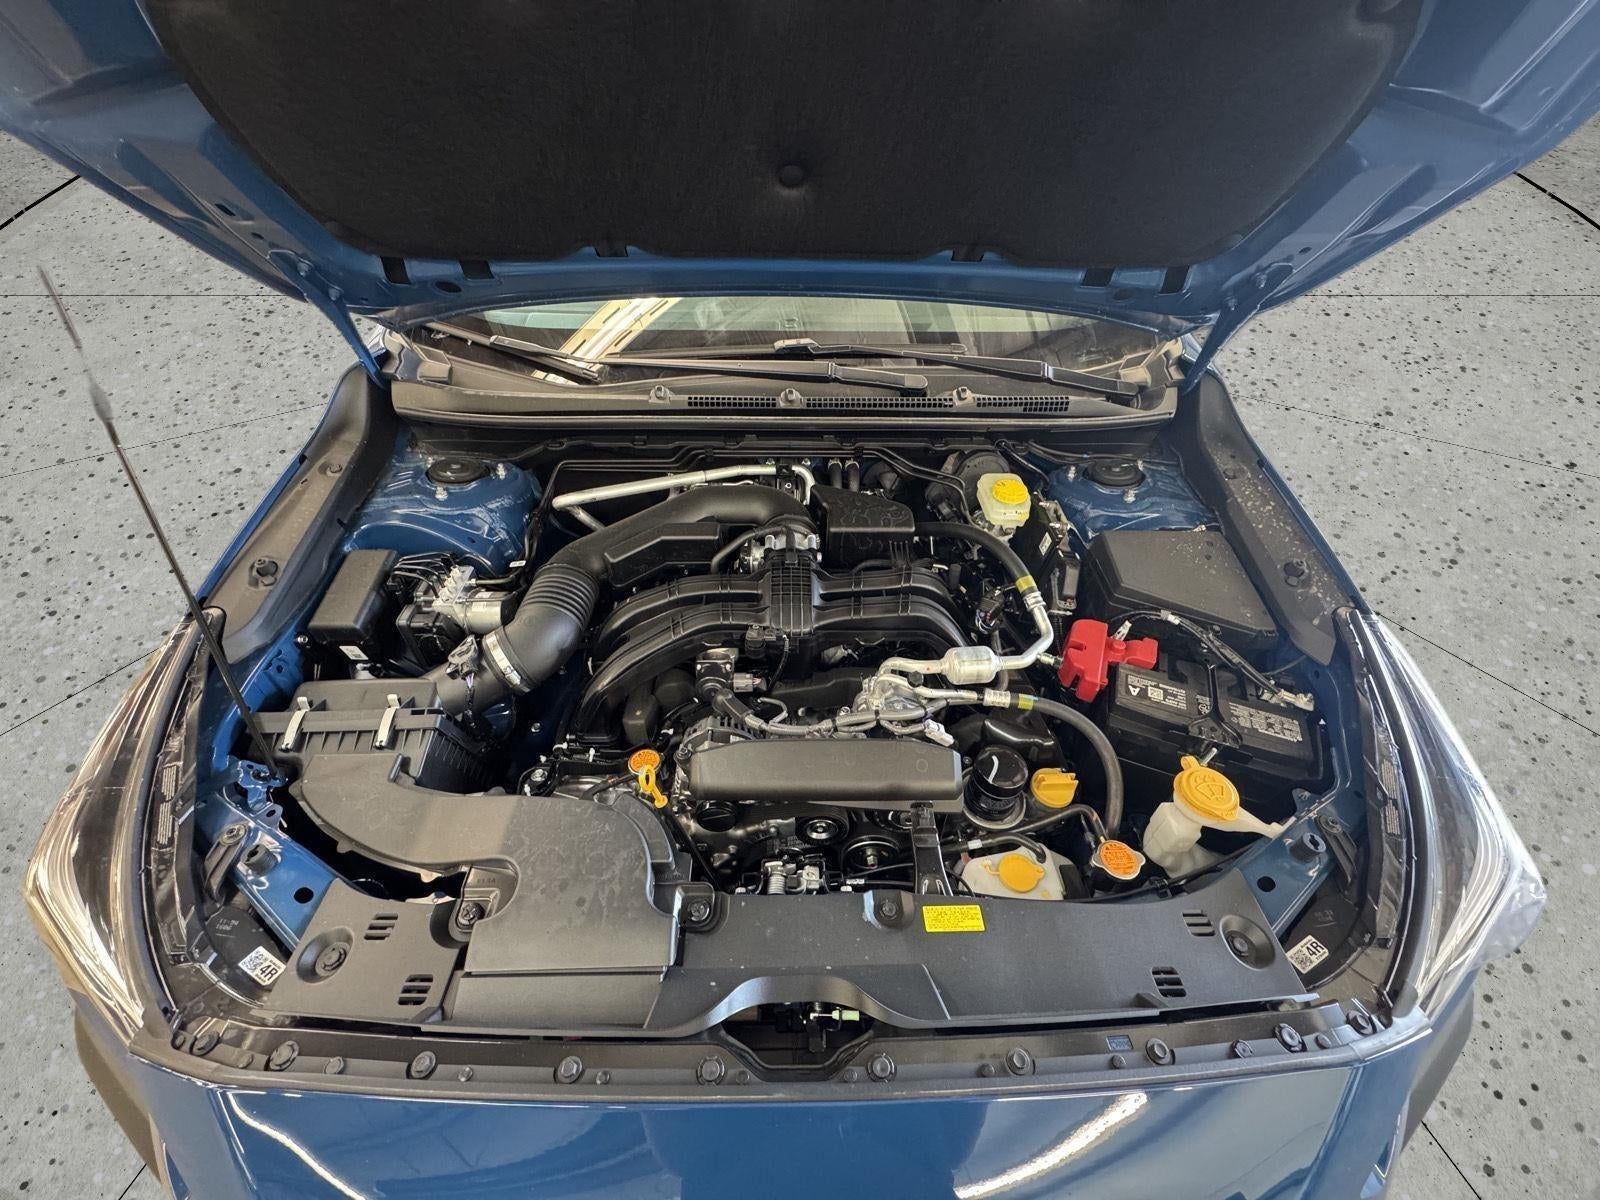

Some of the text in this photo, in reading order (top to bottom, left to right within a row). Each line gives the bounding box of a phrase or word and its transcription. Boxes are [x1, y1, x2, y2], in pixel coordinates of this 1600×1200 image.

[1128, 685, 1140, 696] A
[1306, 941, 1325, 957] 4R
[260, 964, 278, 981] 4R
